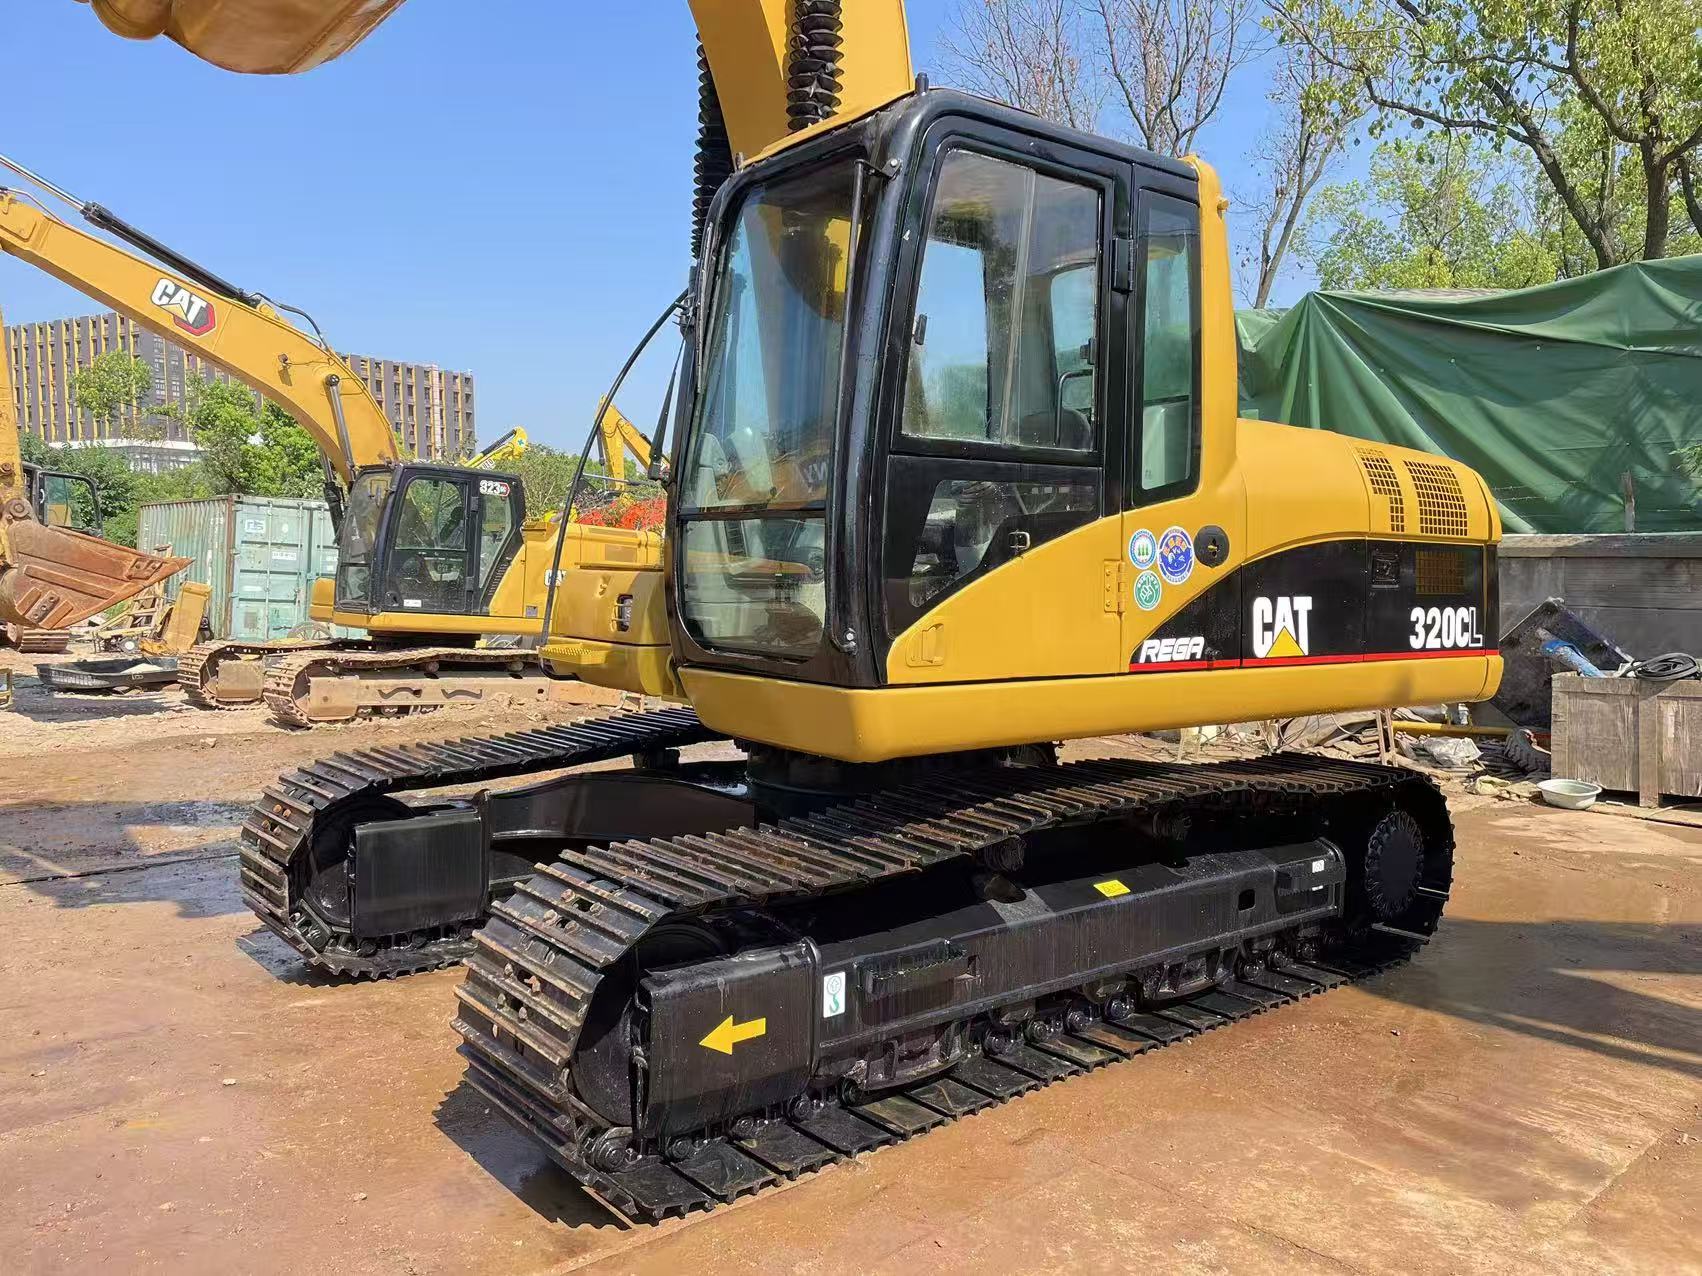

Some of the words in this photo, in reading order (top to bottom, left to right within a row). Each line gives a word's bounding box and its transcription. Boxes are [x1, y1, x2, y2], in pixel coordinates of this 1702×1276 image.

[151, 278, 208, 324] CAT
[480, 480, 500, 496] 323
[1253, 596, 1312, 658] CAT
[1139, 636, 1205, 663] REGA
